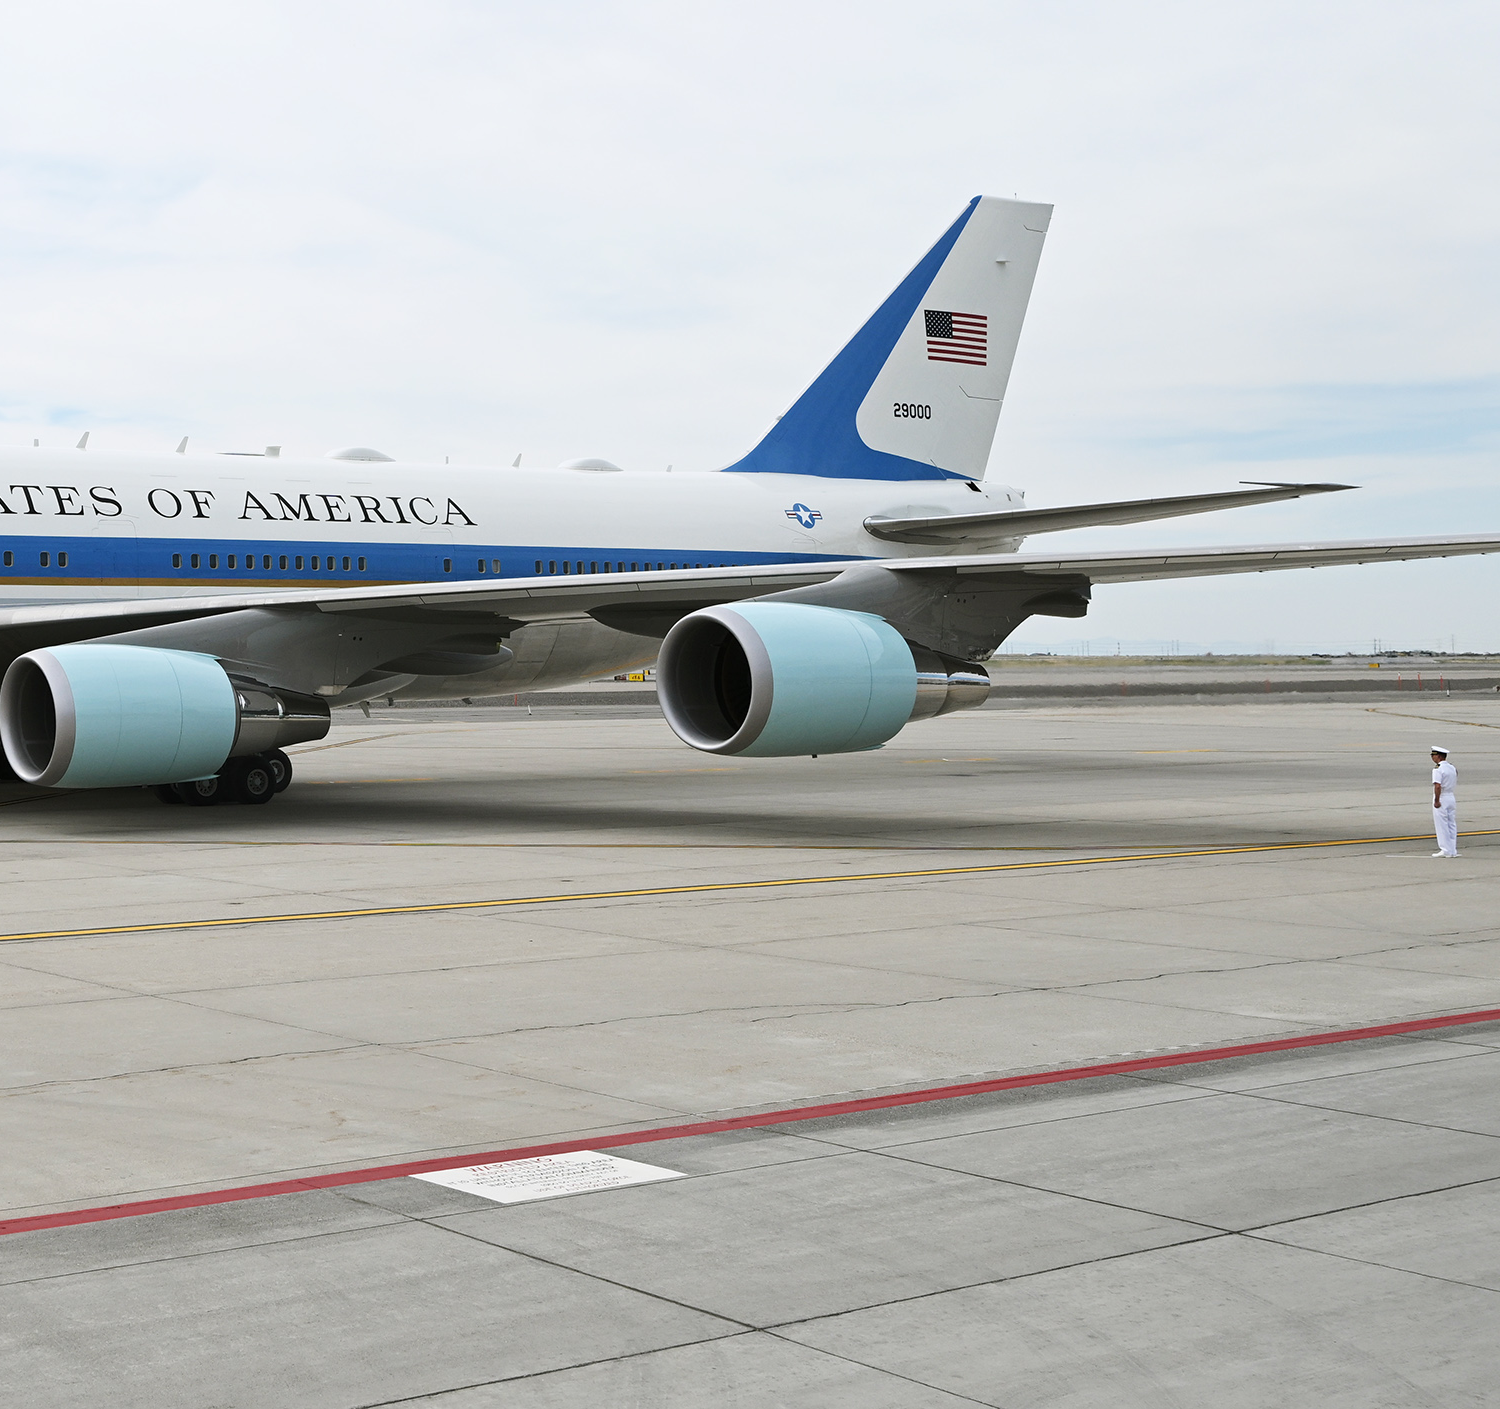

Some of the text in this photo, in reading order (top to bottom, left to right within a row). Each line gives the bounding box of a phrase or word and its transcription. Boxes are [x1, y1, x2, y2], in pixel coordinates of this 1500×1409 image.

[894, 403, 931, 419] 29000
[148, 489, 215, 518] OF
[238, 491, 477, 525] AMERICA
